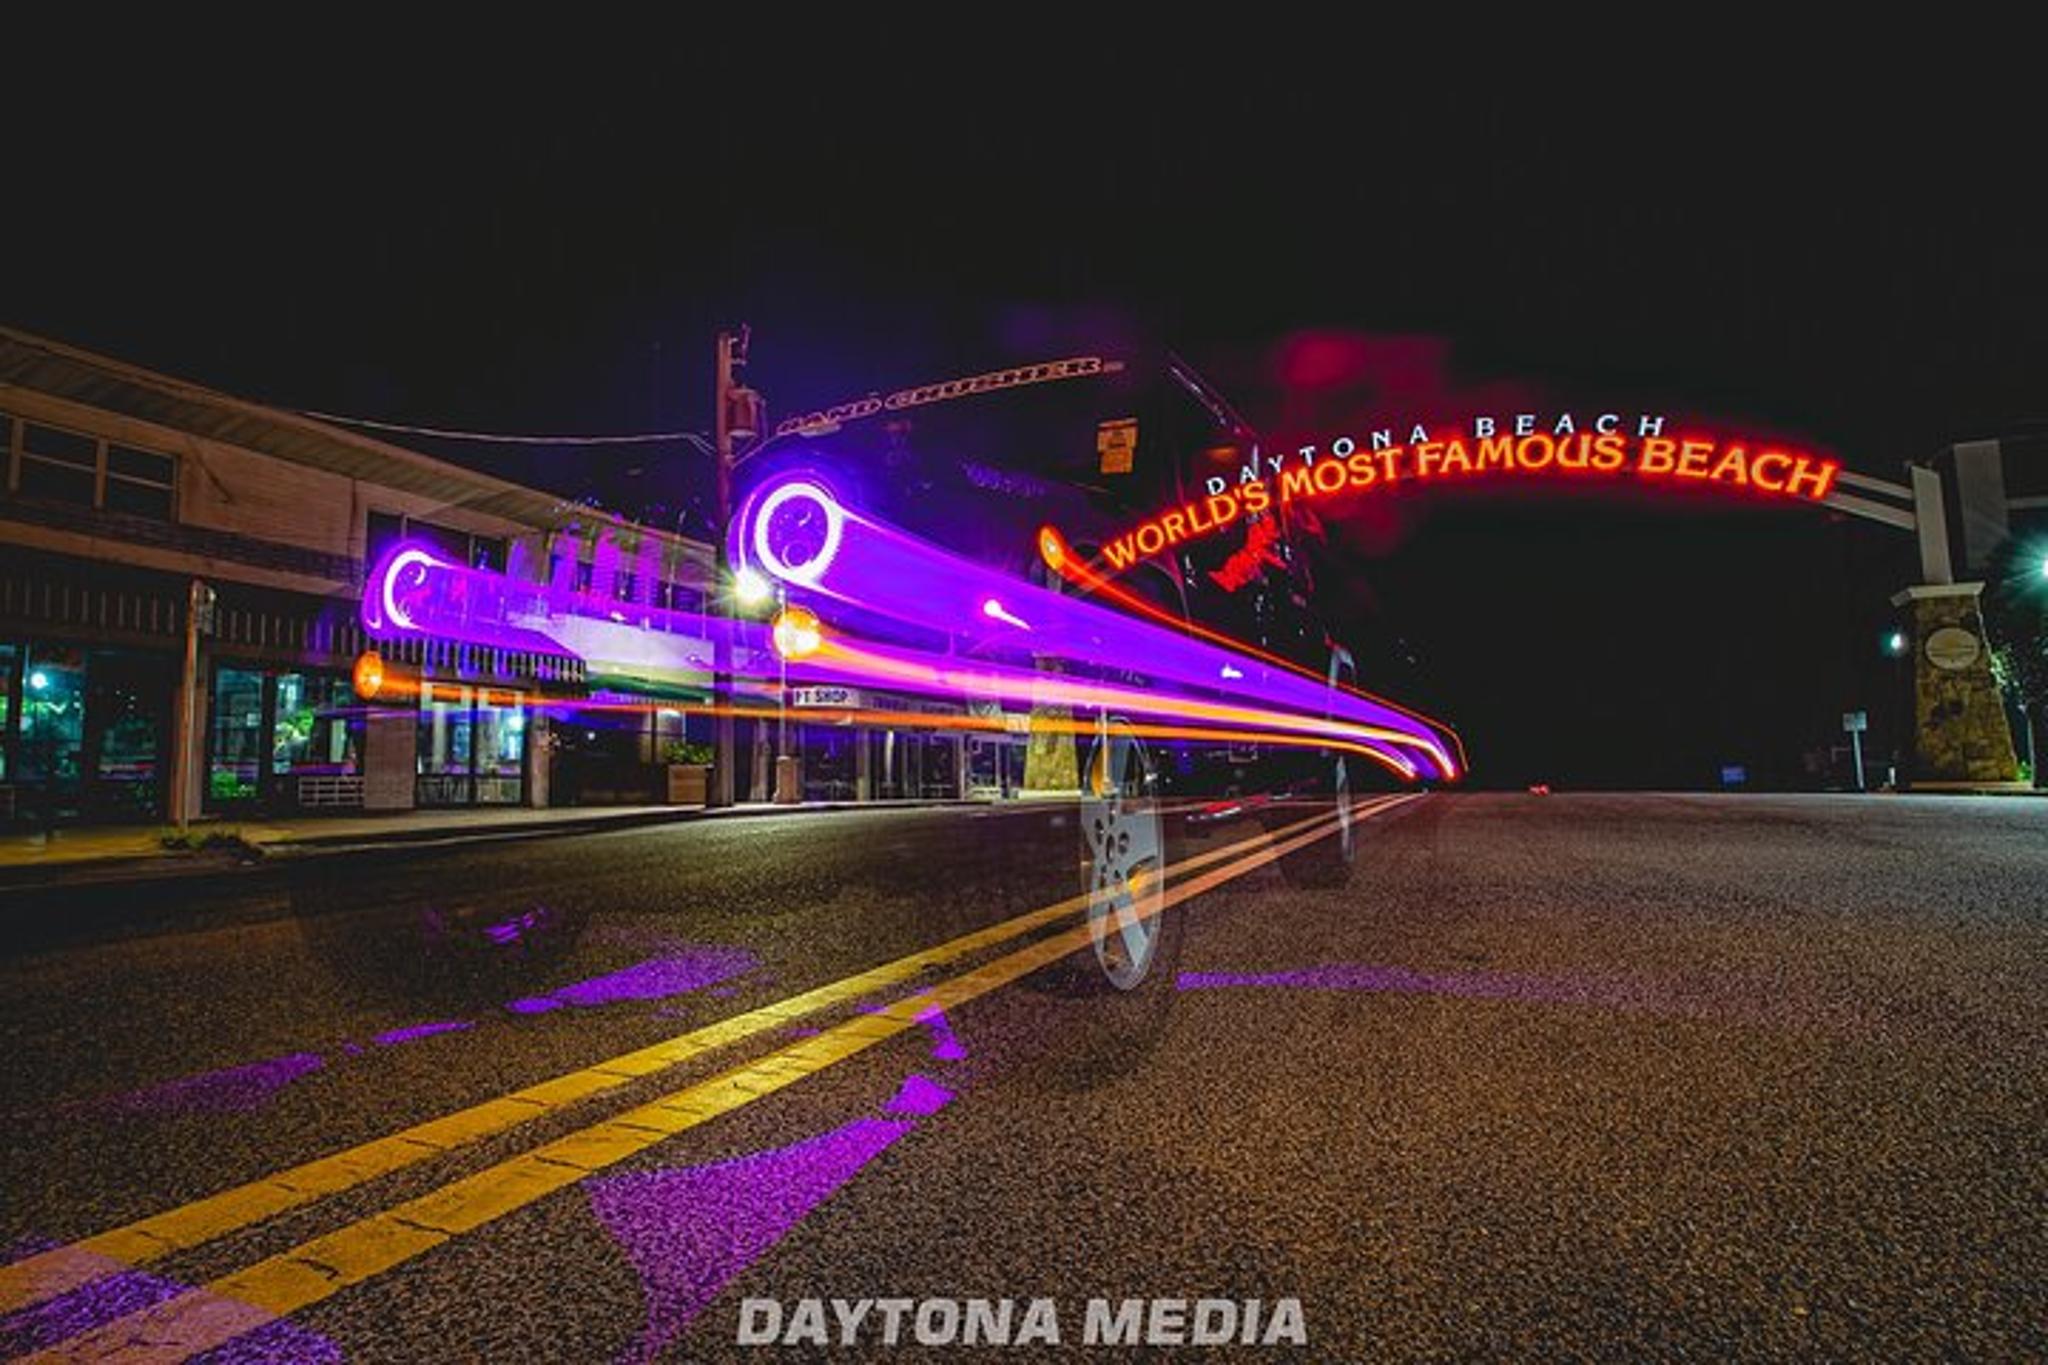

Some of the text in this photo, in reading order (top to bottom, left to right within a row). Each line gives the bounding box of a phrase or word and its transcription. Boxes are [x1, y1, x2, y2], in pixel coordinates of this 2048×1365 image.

[1205, 414, 1664, 496] DAYTONA BEACH
[1103, 434, 1836, 570] WORLD'S MOST FAMOUS BEACH
[815, 690, 848, 703] SHOP
